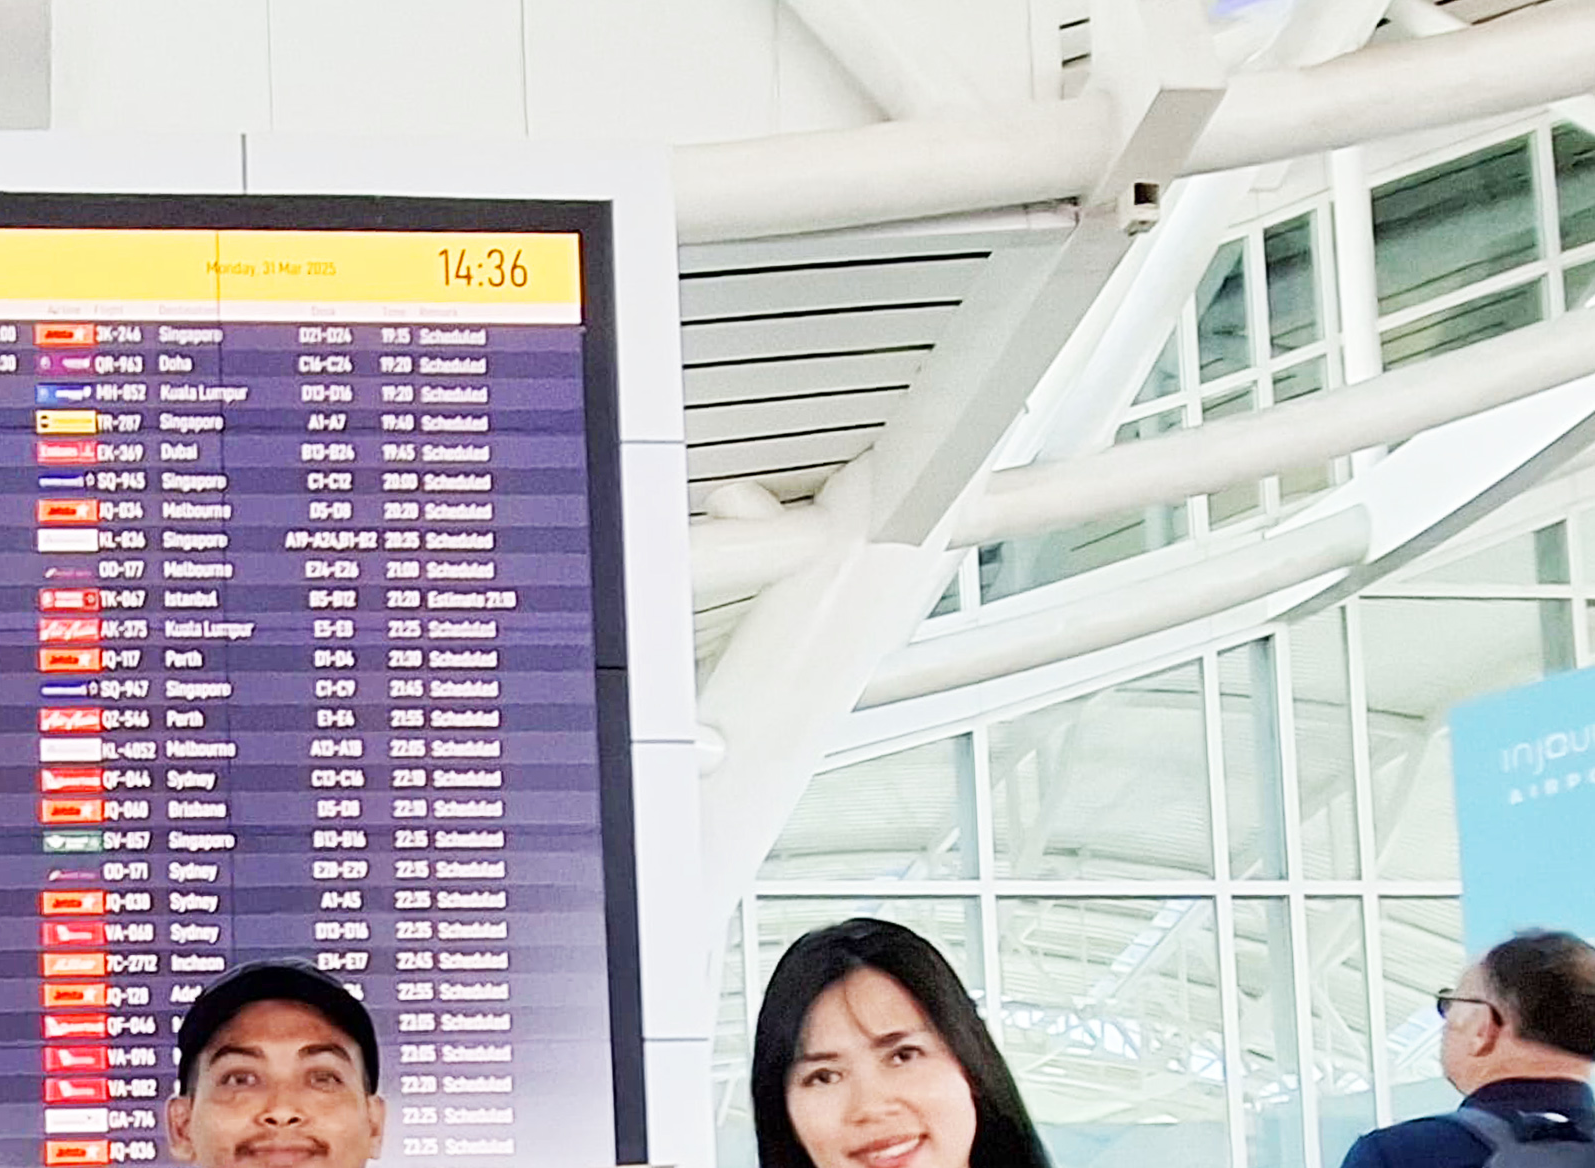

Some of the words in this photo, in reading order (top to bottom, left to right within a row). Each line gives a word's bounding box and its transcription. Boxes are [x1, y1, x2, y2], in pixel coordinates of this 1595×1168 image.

[263, 260, 276, 275] 31
[278, 261, 302, 275] Mar
[306, 261, 337, 276] 2025
[437, 247, 529, 288] 14:36
[159, 326, 223, 345] Singapore
[159, 354, 192, 372] Doha
[160, 384, 197, 401] Kuala
[198, 385, 248, 403] Lumpur
[159, 413, 223, 433] Singapore
[160, 443, 198, 460] Dubai
[161, 472, 227, 492] Singapore
[162, 502, 231, 519] Melbourne
[163, 531, 228, 551] Singapore
[163, 561, 233, 578] Melbourne
[164, 590, 218, 607] Istanbul
[165, 620, 203, 637] Kuala
[203, 620, 254, 640] Lumpur
[165, 650, 202, 667] Perth
[165, 680, 231, 700] Singapore
[166, 710, 204, 727] Perth
[166, 740, 236, 757] Melbourne
[167, 770, 215, 790] Sydney
[168, 831, 235, 852] Singapore
[169, 862, 217, 882] Sydney
[169, 892, 218, 913] Sydney
[170, 923, 219, 944] Sydney
